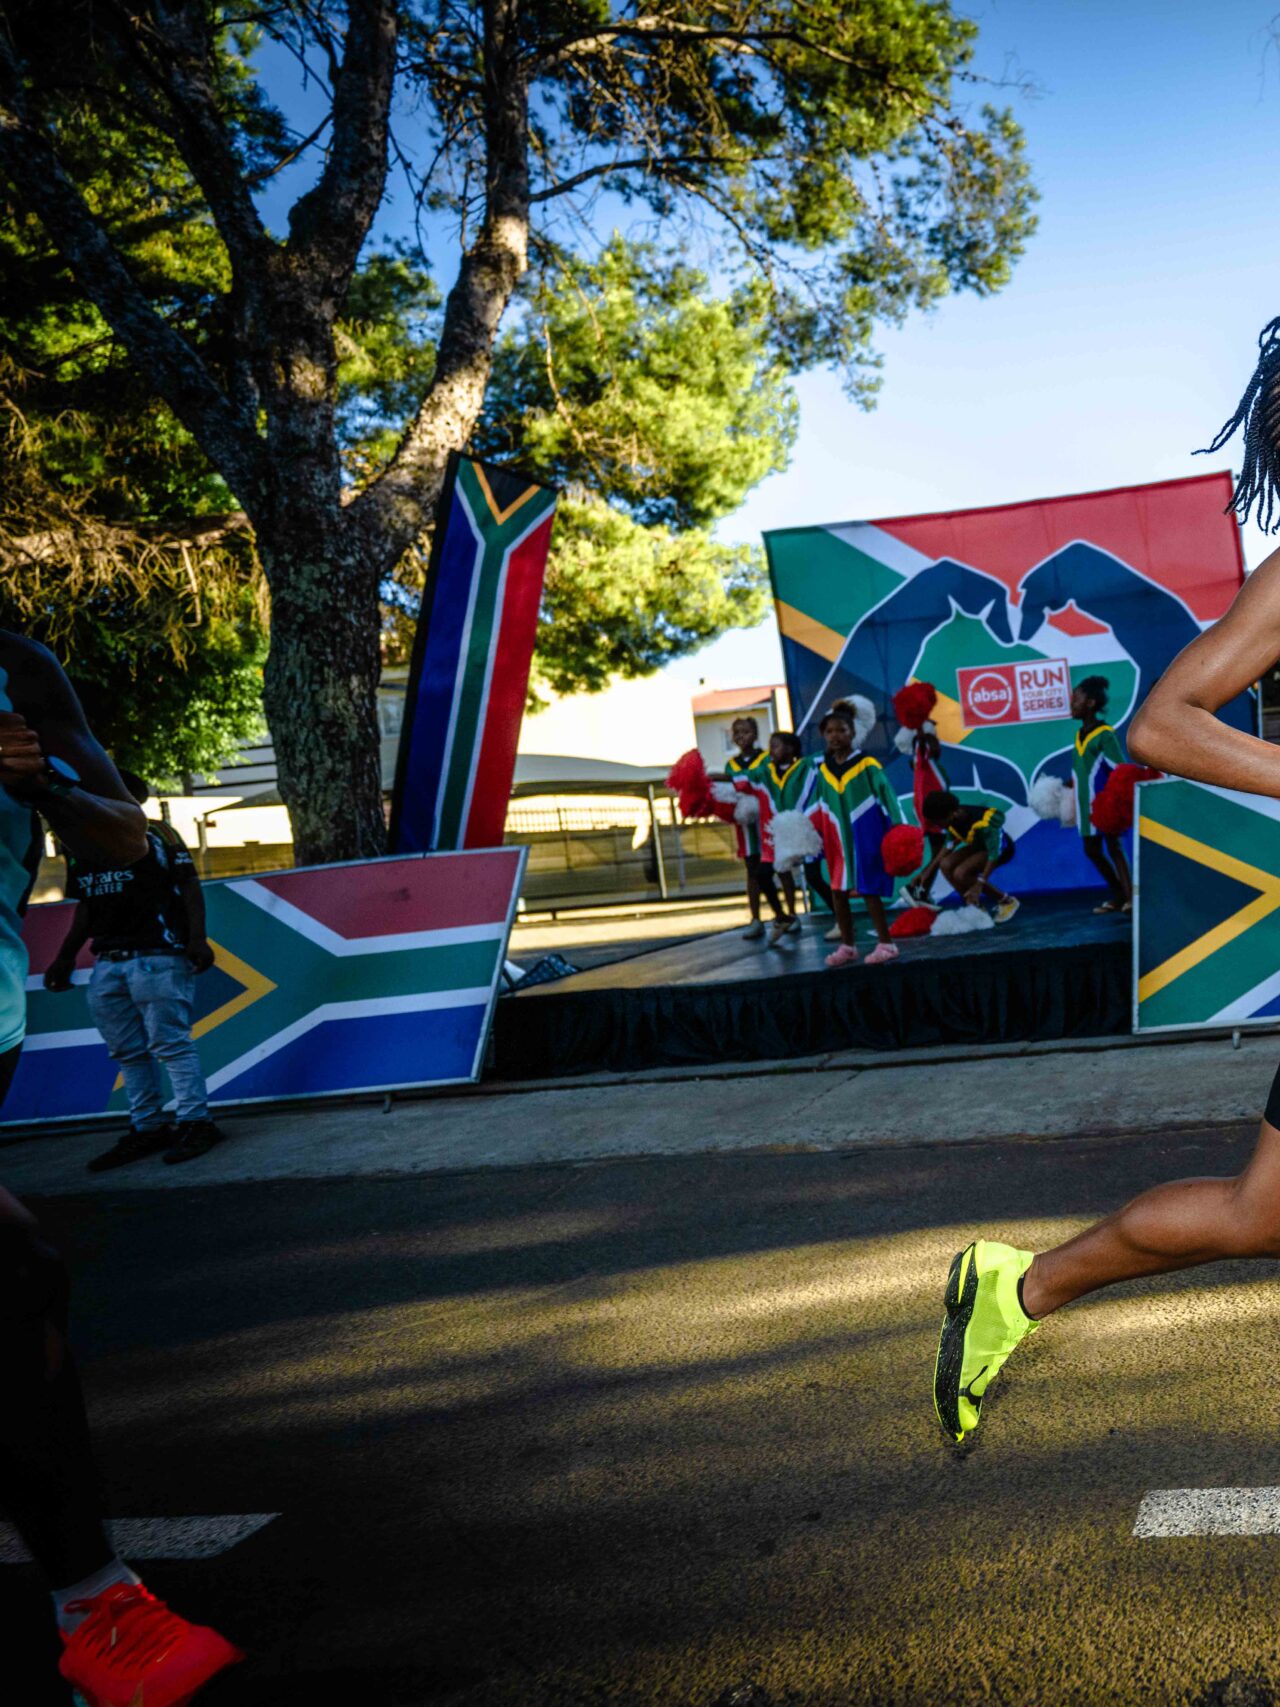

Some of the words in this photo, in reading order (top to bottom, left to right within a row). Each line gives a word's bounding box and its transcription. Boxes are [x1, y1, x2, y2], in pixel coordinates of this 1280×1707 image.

[1019, 667, 1064, 689] RUN
[974, 687, 1008, 702] absa
[1022, 689, 1043, 698] YOUR
[1045, 688, 1063, 696] CITY
[1022, 697, 1064, 712] SERIES
